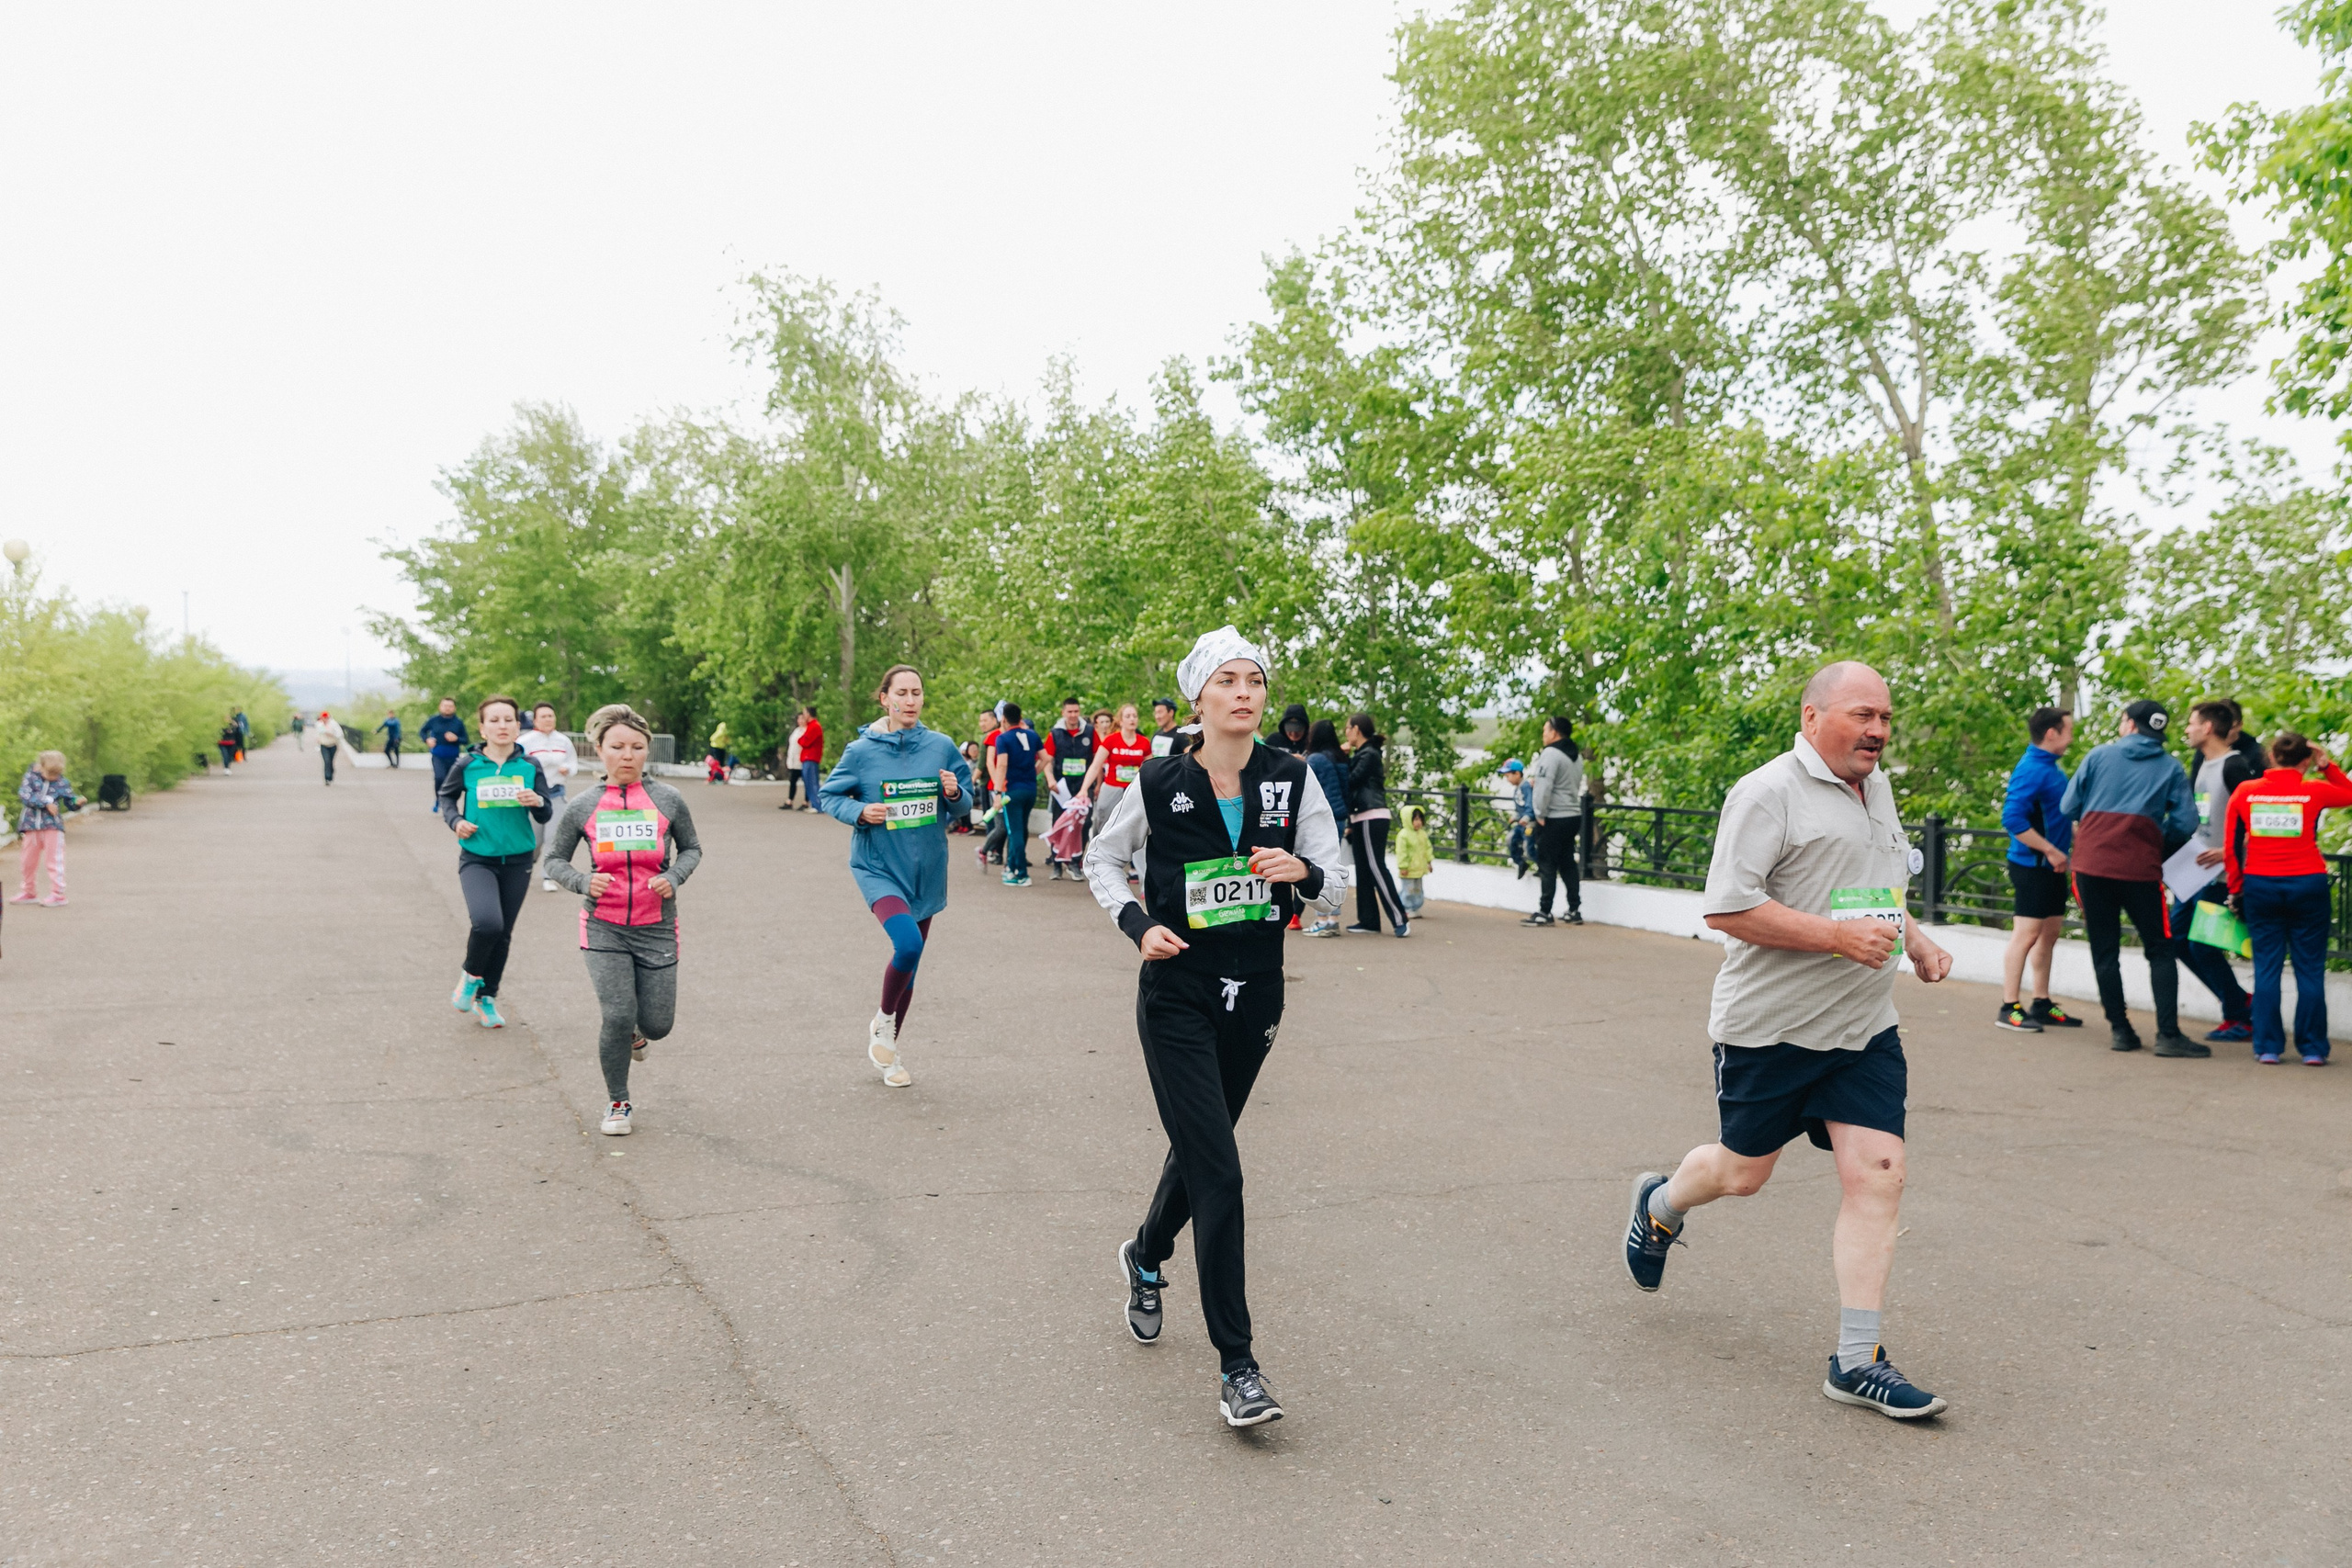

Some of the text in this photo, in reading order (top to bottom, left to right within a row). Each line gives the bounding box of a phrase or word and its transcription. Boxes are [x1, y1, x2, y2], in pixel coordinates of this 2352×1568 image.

[1259, 781, 1293, 810] 67
[901, 801, 933, 817] 0798
[1171, 802, 1194, 814] Kappa
[616, 824, 653, 838] 0155
[1214, 878, 1267, 904] 0217
